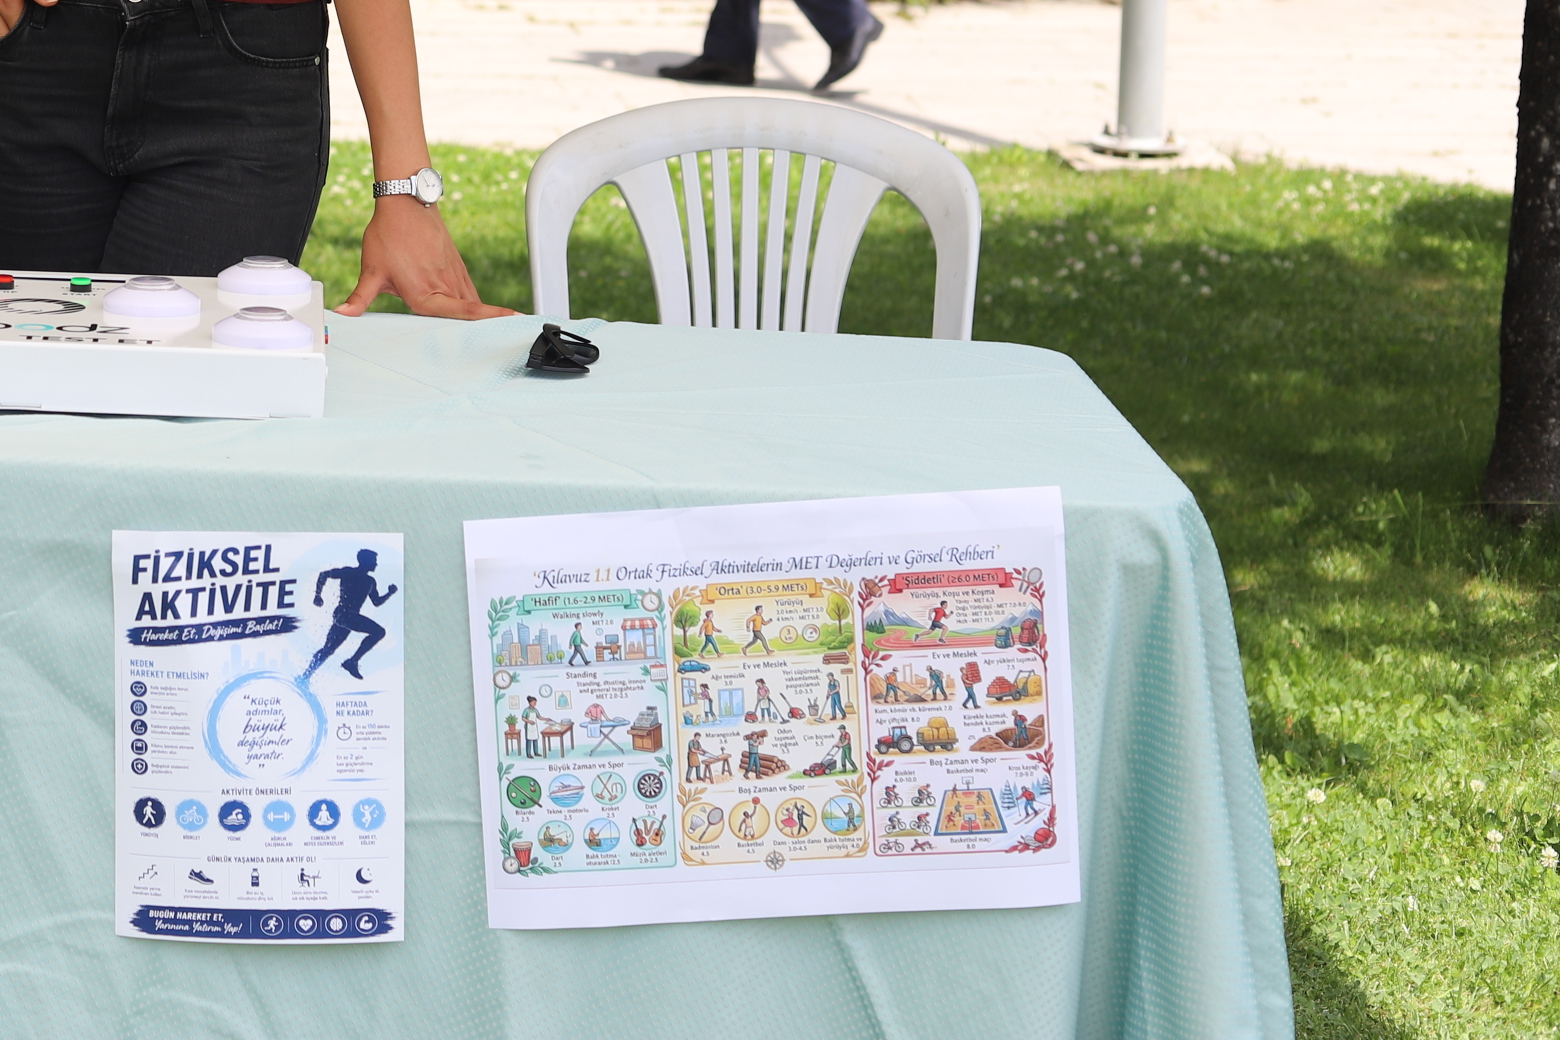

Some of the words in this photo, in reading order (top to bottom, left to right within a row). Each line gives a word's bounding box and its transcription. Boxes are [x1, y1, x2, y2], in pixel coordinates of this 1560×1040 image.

[19, 335, 107, 343] TEST
[131, 544, 280, 585] FİZİKSEL
[594, 567, 611, 582] 1.1
[616, 562, 653, 582] Ortak
[655, 560, 706, 585] Fiziksel
[704, 554, 783, 578] Aktivitelerin
[785, 554, 823, 573] MET
[825, 550, 884, 573] Değerleri
[887, 554, 901, 566] ve
[904, 547, 943, 570] Görsel
[947, 574, 971, 585] (≥6.0
[973, 573, 999, 583] METs)
[781, 583, 808, 592] METs)
[971, 588, 996, 597] Koşma
[134, 578, 297, 621] AKTİVİTE
[597, 594, 624, 603] METs)
[775, 599, 804, 607] Yürüyüş
[552, 611, 580, 620] Walking
[582, 610, 604, 619] slowly
[141, 629, 179, 643] Hareket
[182, 626, 198, 640] Et,
[201, 623, 244, 639] Değişimi
[245, 618, 284, 634] Başlat!
[952, 650, 978, 658] Meslek
[130, 659, 154, 668] NEDEN
[742, 662, 752, 670] Ev
[762, 660, 788, 668] Meslek
[130, 668, 164, 679] HAREKET
[166, 670, 209, 681] ETMELİSİN?
[566, 671, 597, 680] Standing
[245, 707, 285, 717] adımlar,
[347, 709, 374, 717] KADAR?
[243, 717, 287, 735] büyük
[236, 736, 293, 750] değişimler
[245, 749, 284, 767] yaratır.
[930, 758, 942, 767] Boş
[944, 758, 969, 766] Zaman
[980, 757, 997, 765] Spor
[548, 763, 571, 772] Büyük
[572, 762, 597, 771] Zaman
[608, 762, 624, 770] Spor
[221, 788, 253, 796] AKTİVİTE
[255, 785, 292, 796] ÖNERİLERİ
[738, 785, 752, 795] Boş
[753, 785, 777, 794] Zaman
[788, 784, 805, 793] Spor
[207, 855, 232, 863] GÜNLÜK
[286, 855, 304, 863] AKTİF
[148, 910, 175, 920] BUGÜN
[176, 911, 211, 921] HAREKET
[213, 913, 224, 922] ET,
[154, 920, 189, 932] Yarınına
[192, 920, 222, 933] Yatırım
[224, 922, 243, 935] Yap!
